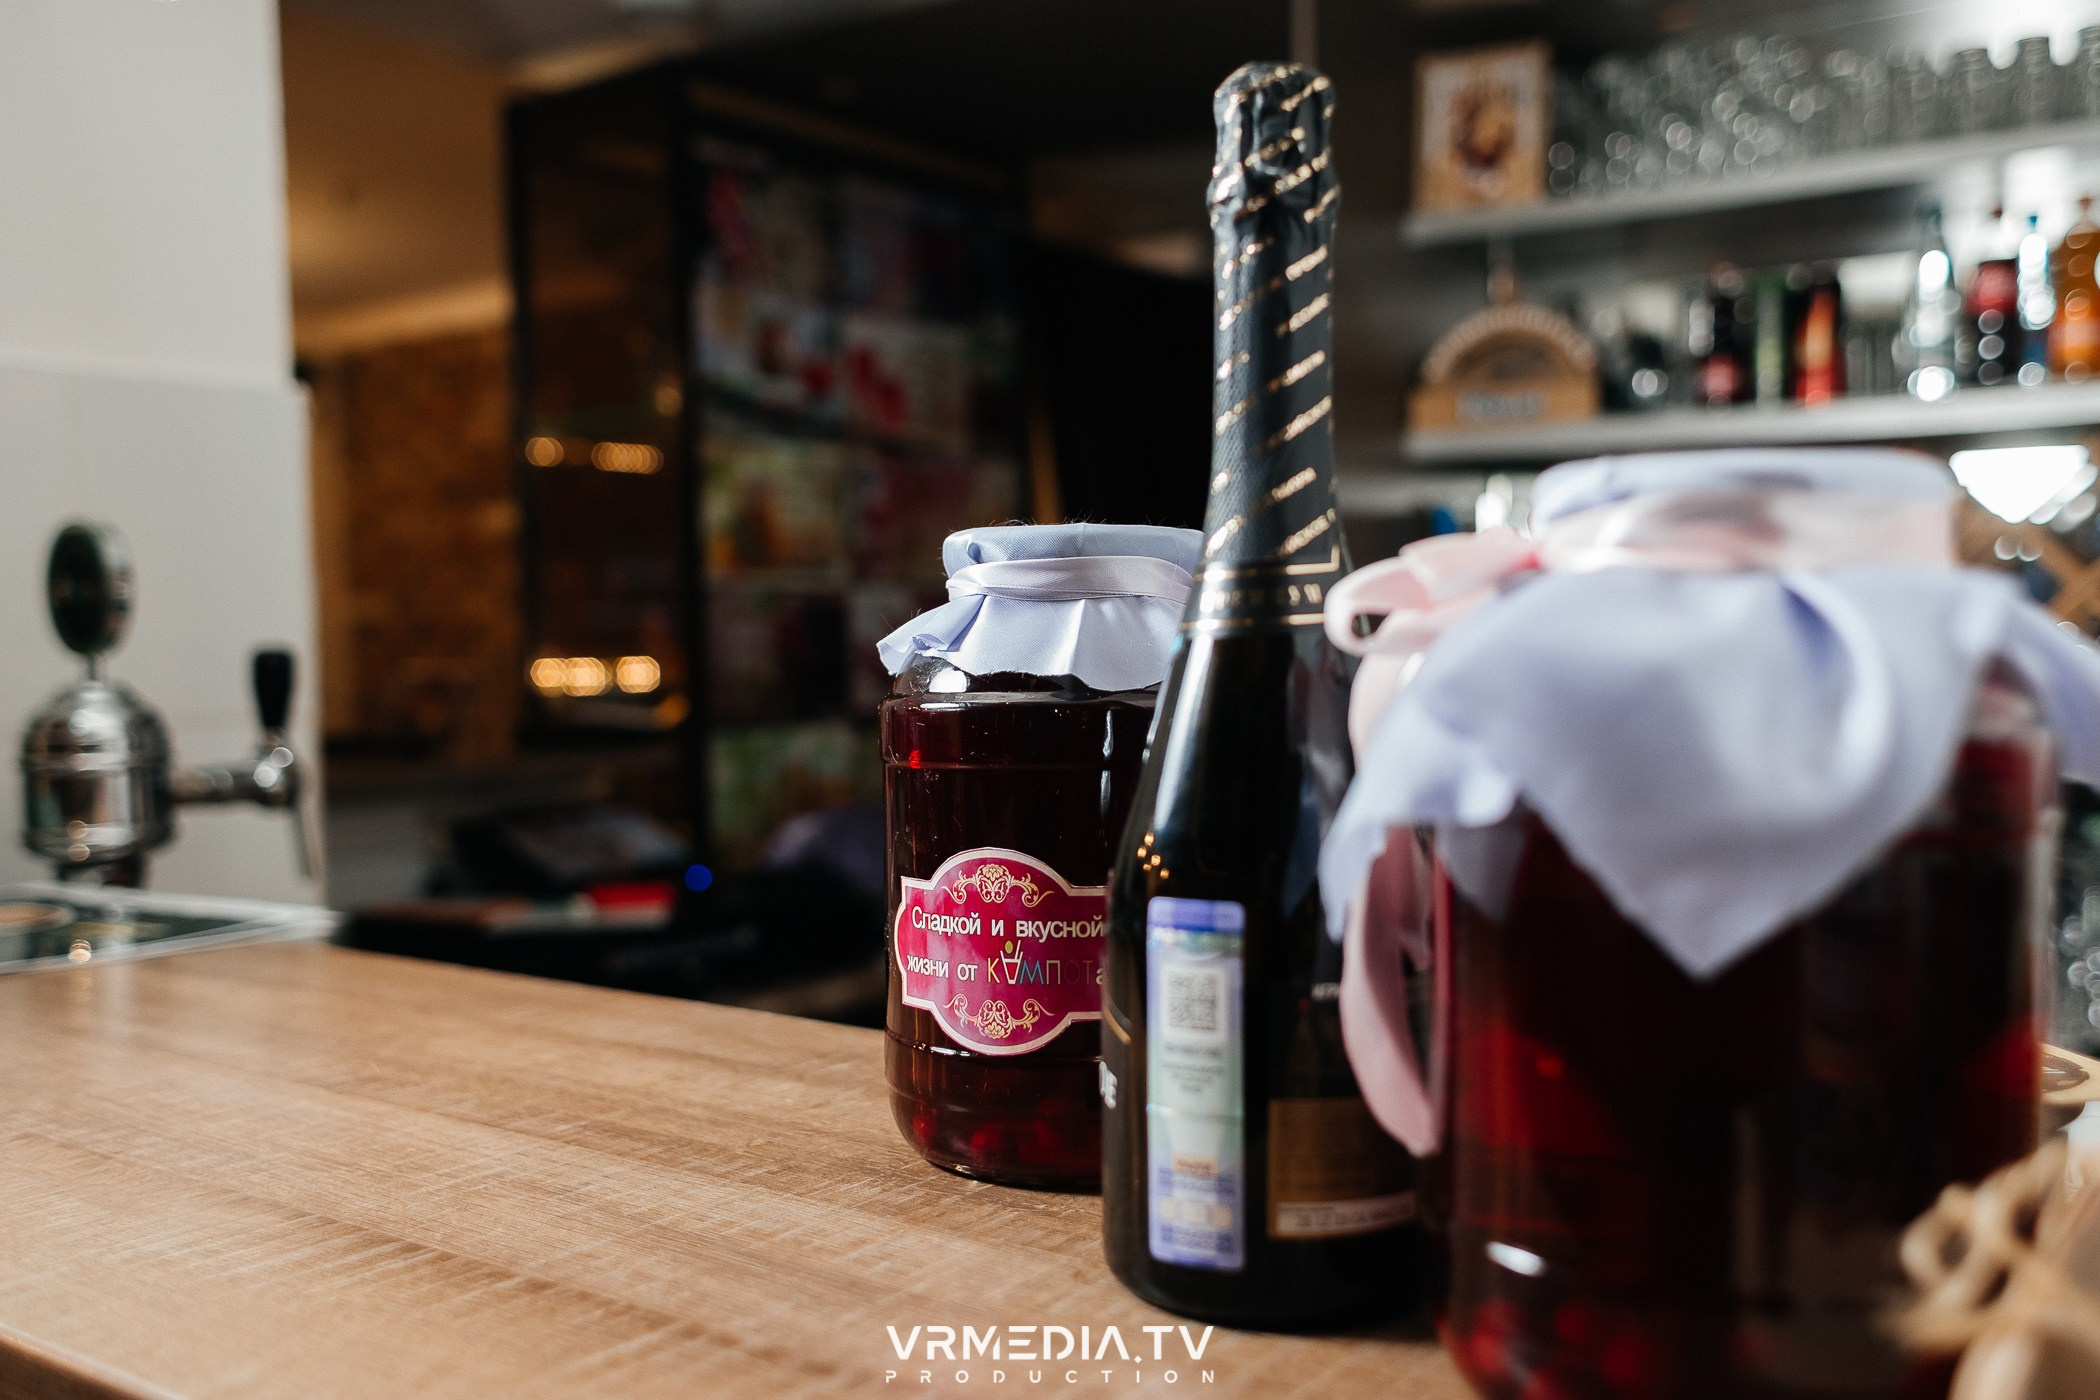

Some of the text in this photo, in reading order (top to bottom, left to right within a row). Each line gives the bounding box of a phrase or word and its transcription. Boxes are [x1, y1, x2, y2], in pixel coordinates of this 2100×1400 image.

[912, 906, 1105, 942] Сладкой и вкусной
[907, 955, 949, 978] жизни
[957, 963, 978, 982] от
